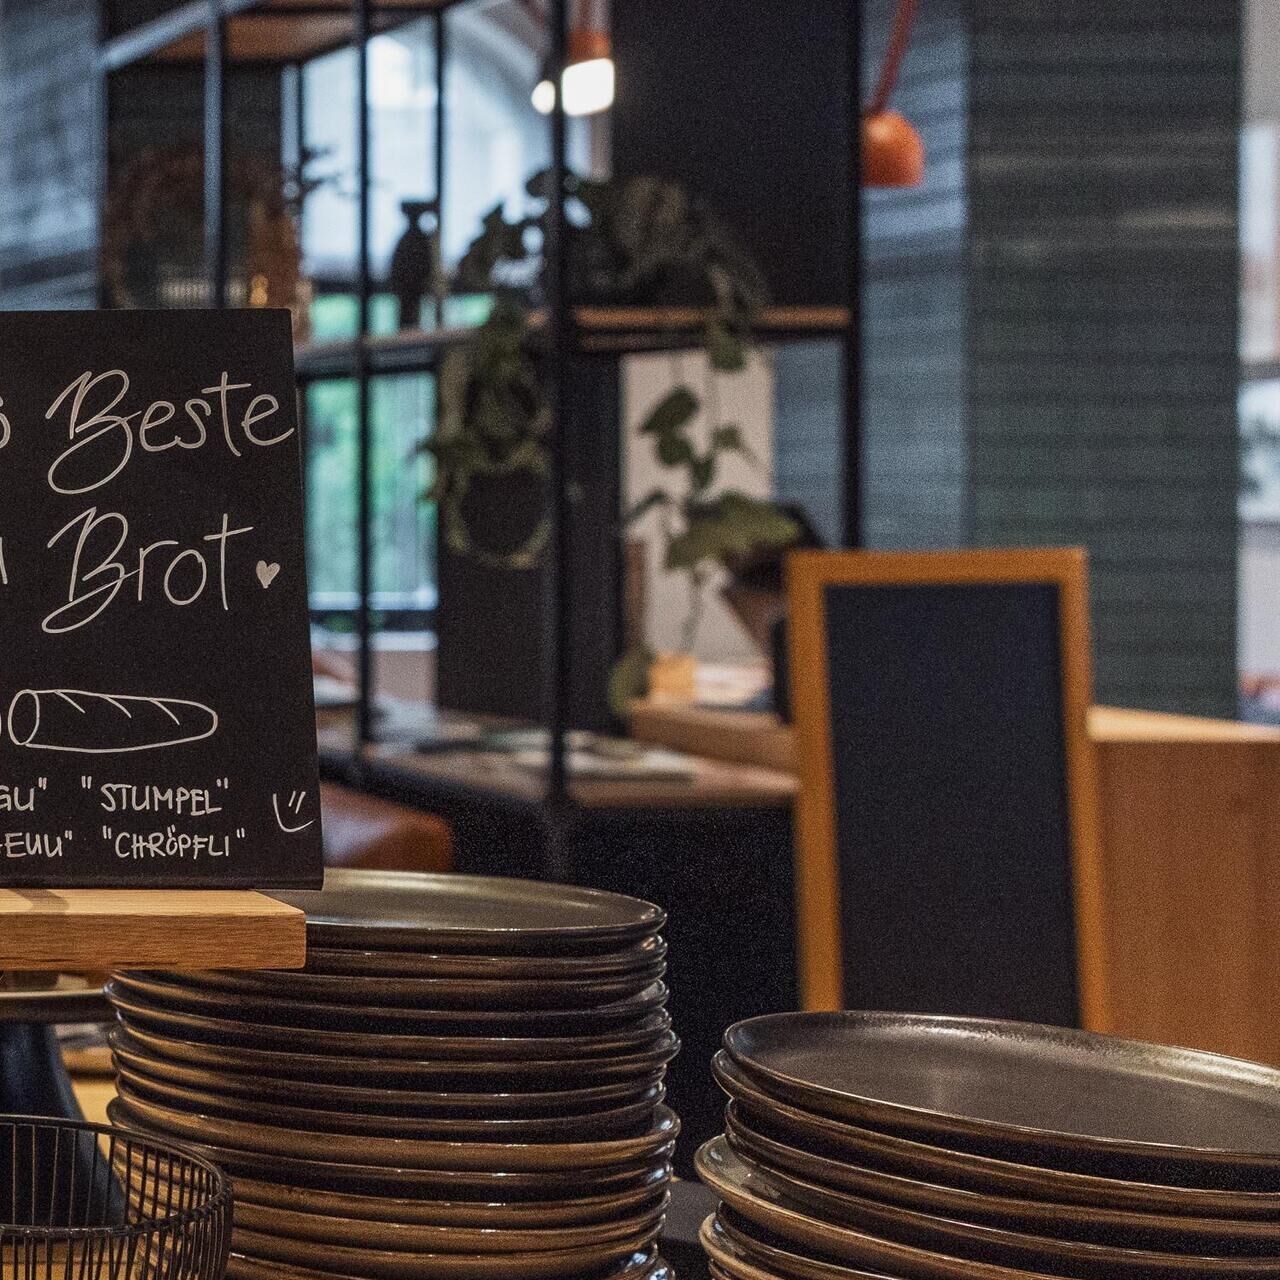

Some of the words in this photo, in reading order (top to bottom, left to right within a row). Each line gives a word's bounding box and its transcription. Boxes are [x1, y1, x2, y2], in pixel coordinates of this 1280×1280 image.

[45, 369, 295, 495] Beste
[41, 506, 254, 634] Brot
[80, 775, 229, 816] "STUMPEL"
